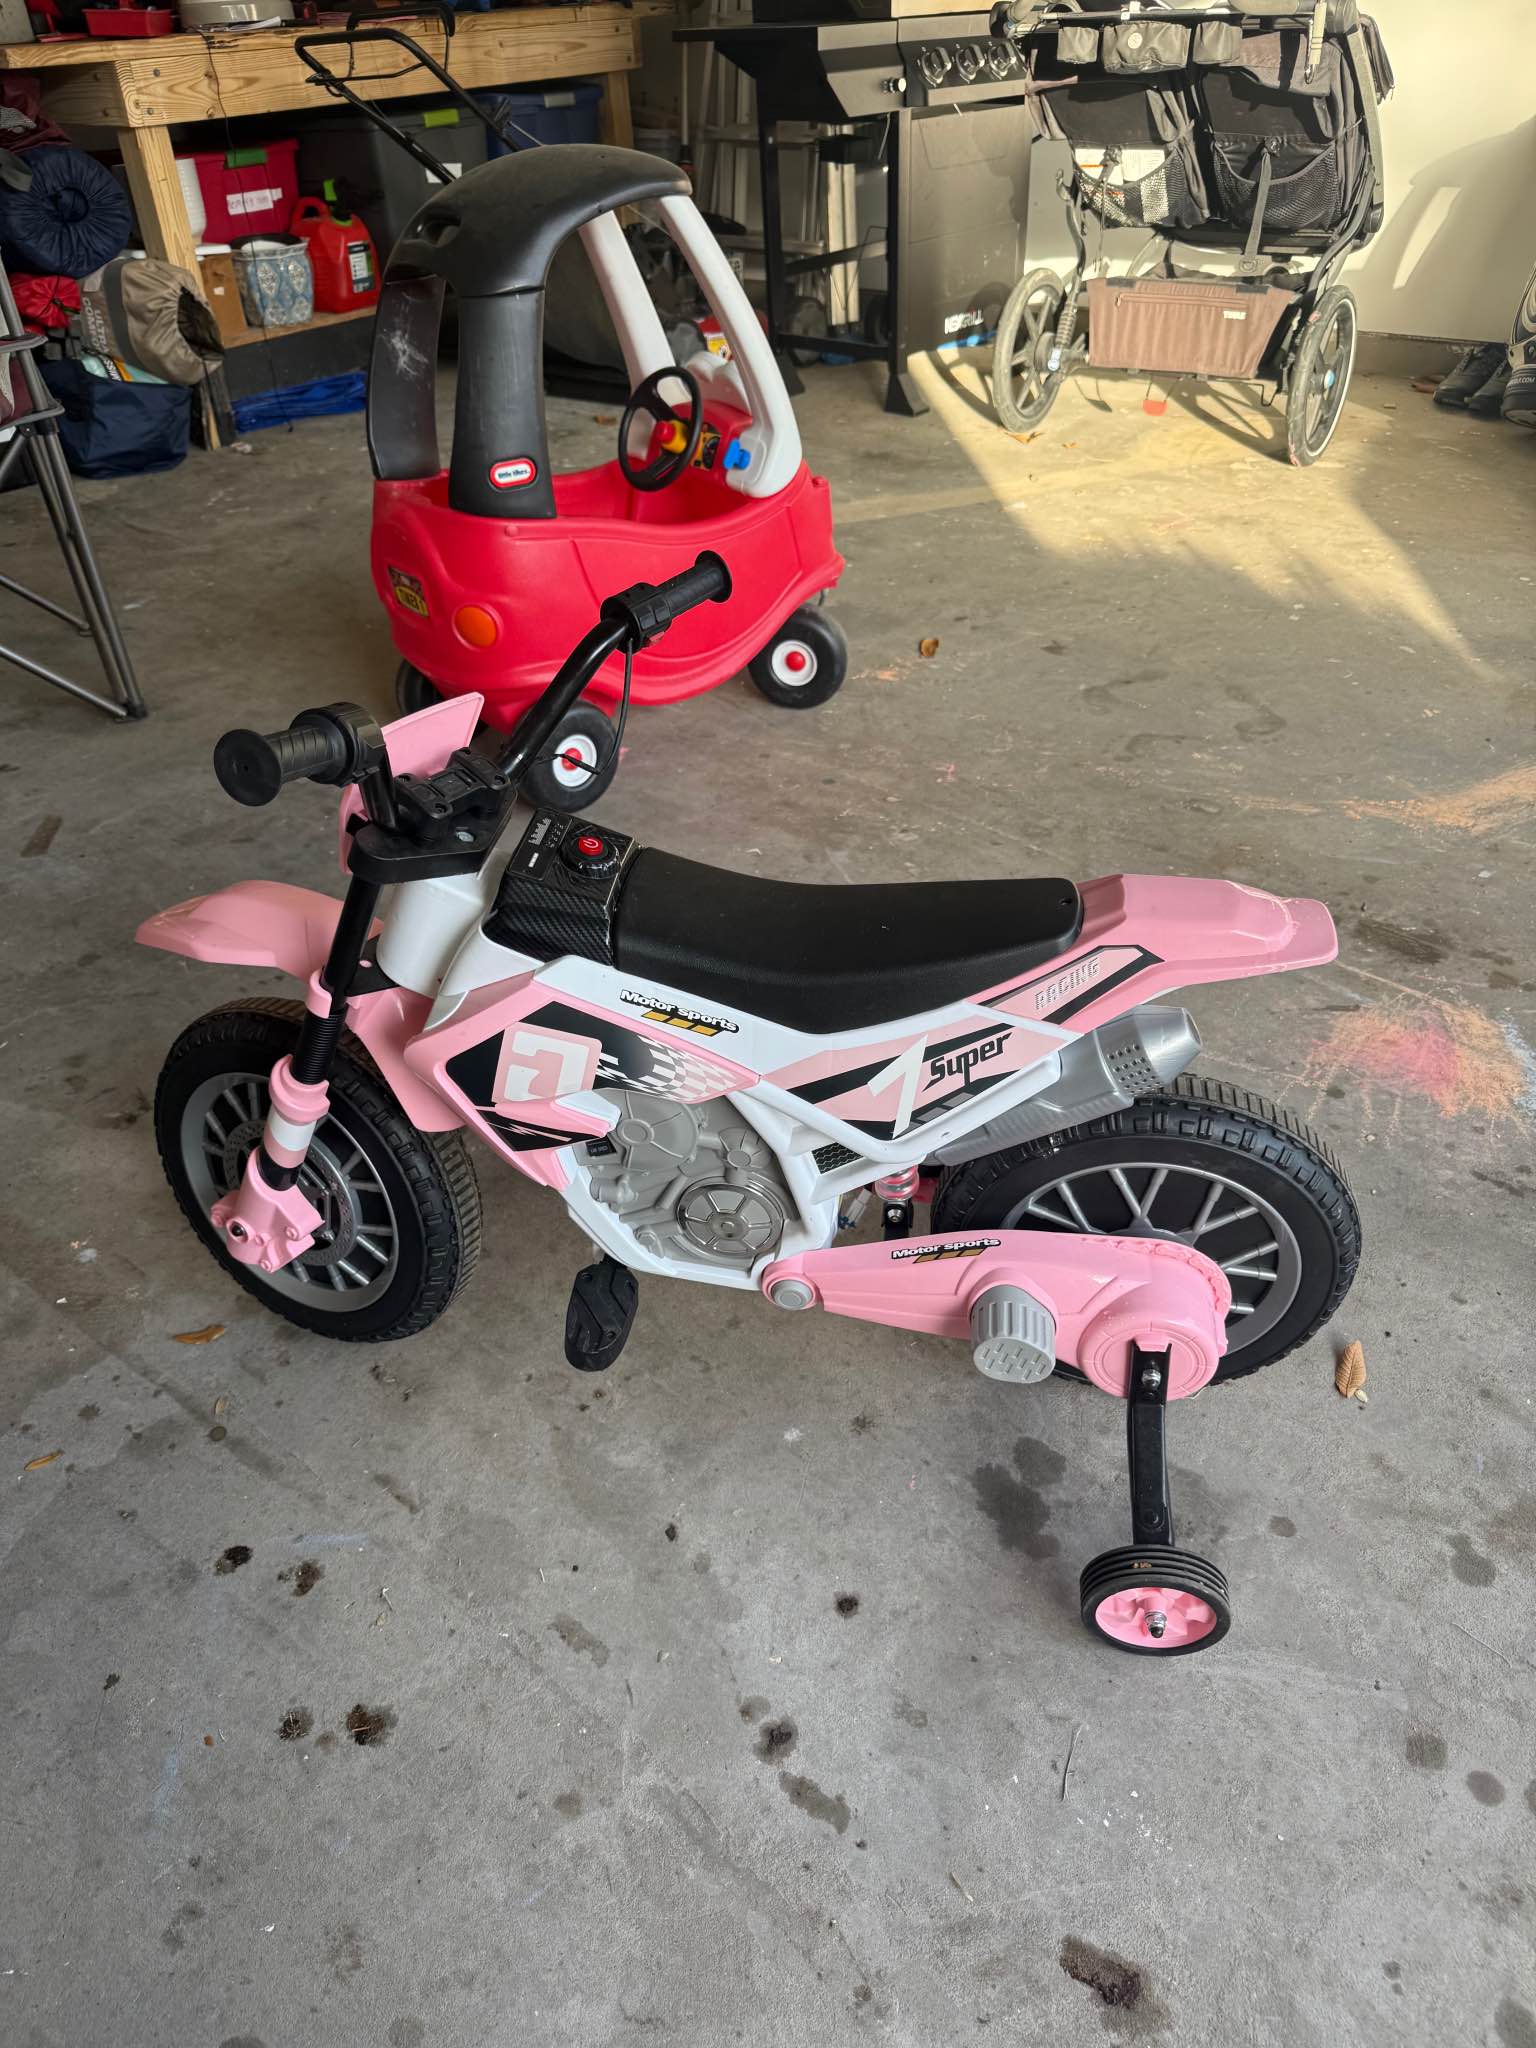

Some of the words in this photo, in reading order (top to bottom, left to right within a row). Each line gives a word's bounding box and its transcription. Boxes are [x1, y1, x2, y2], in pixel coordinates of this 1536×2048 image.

[619, 989, 676, 1012] Motor
[677, 1007, 740, 1033] sports
[922, 1032, 1012, 1093] Super
[891, 1245, 942, 1259] Motor
[943, 1238, 1001, 1251] sports
